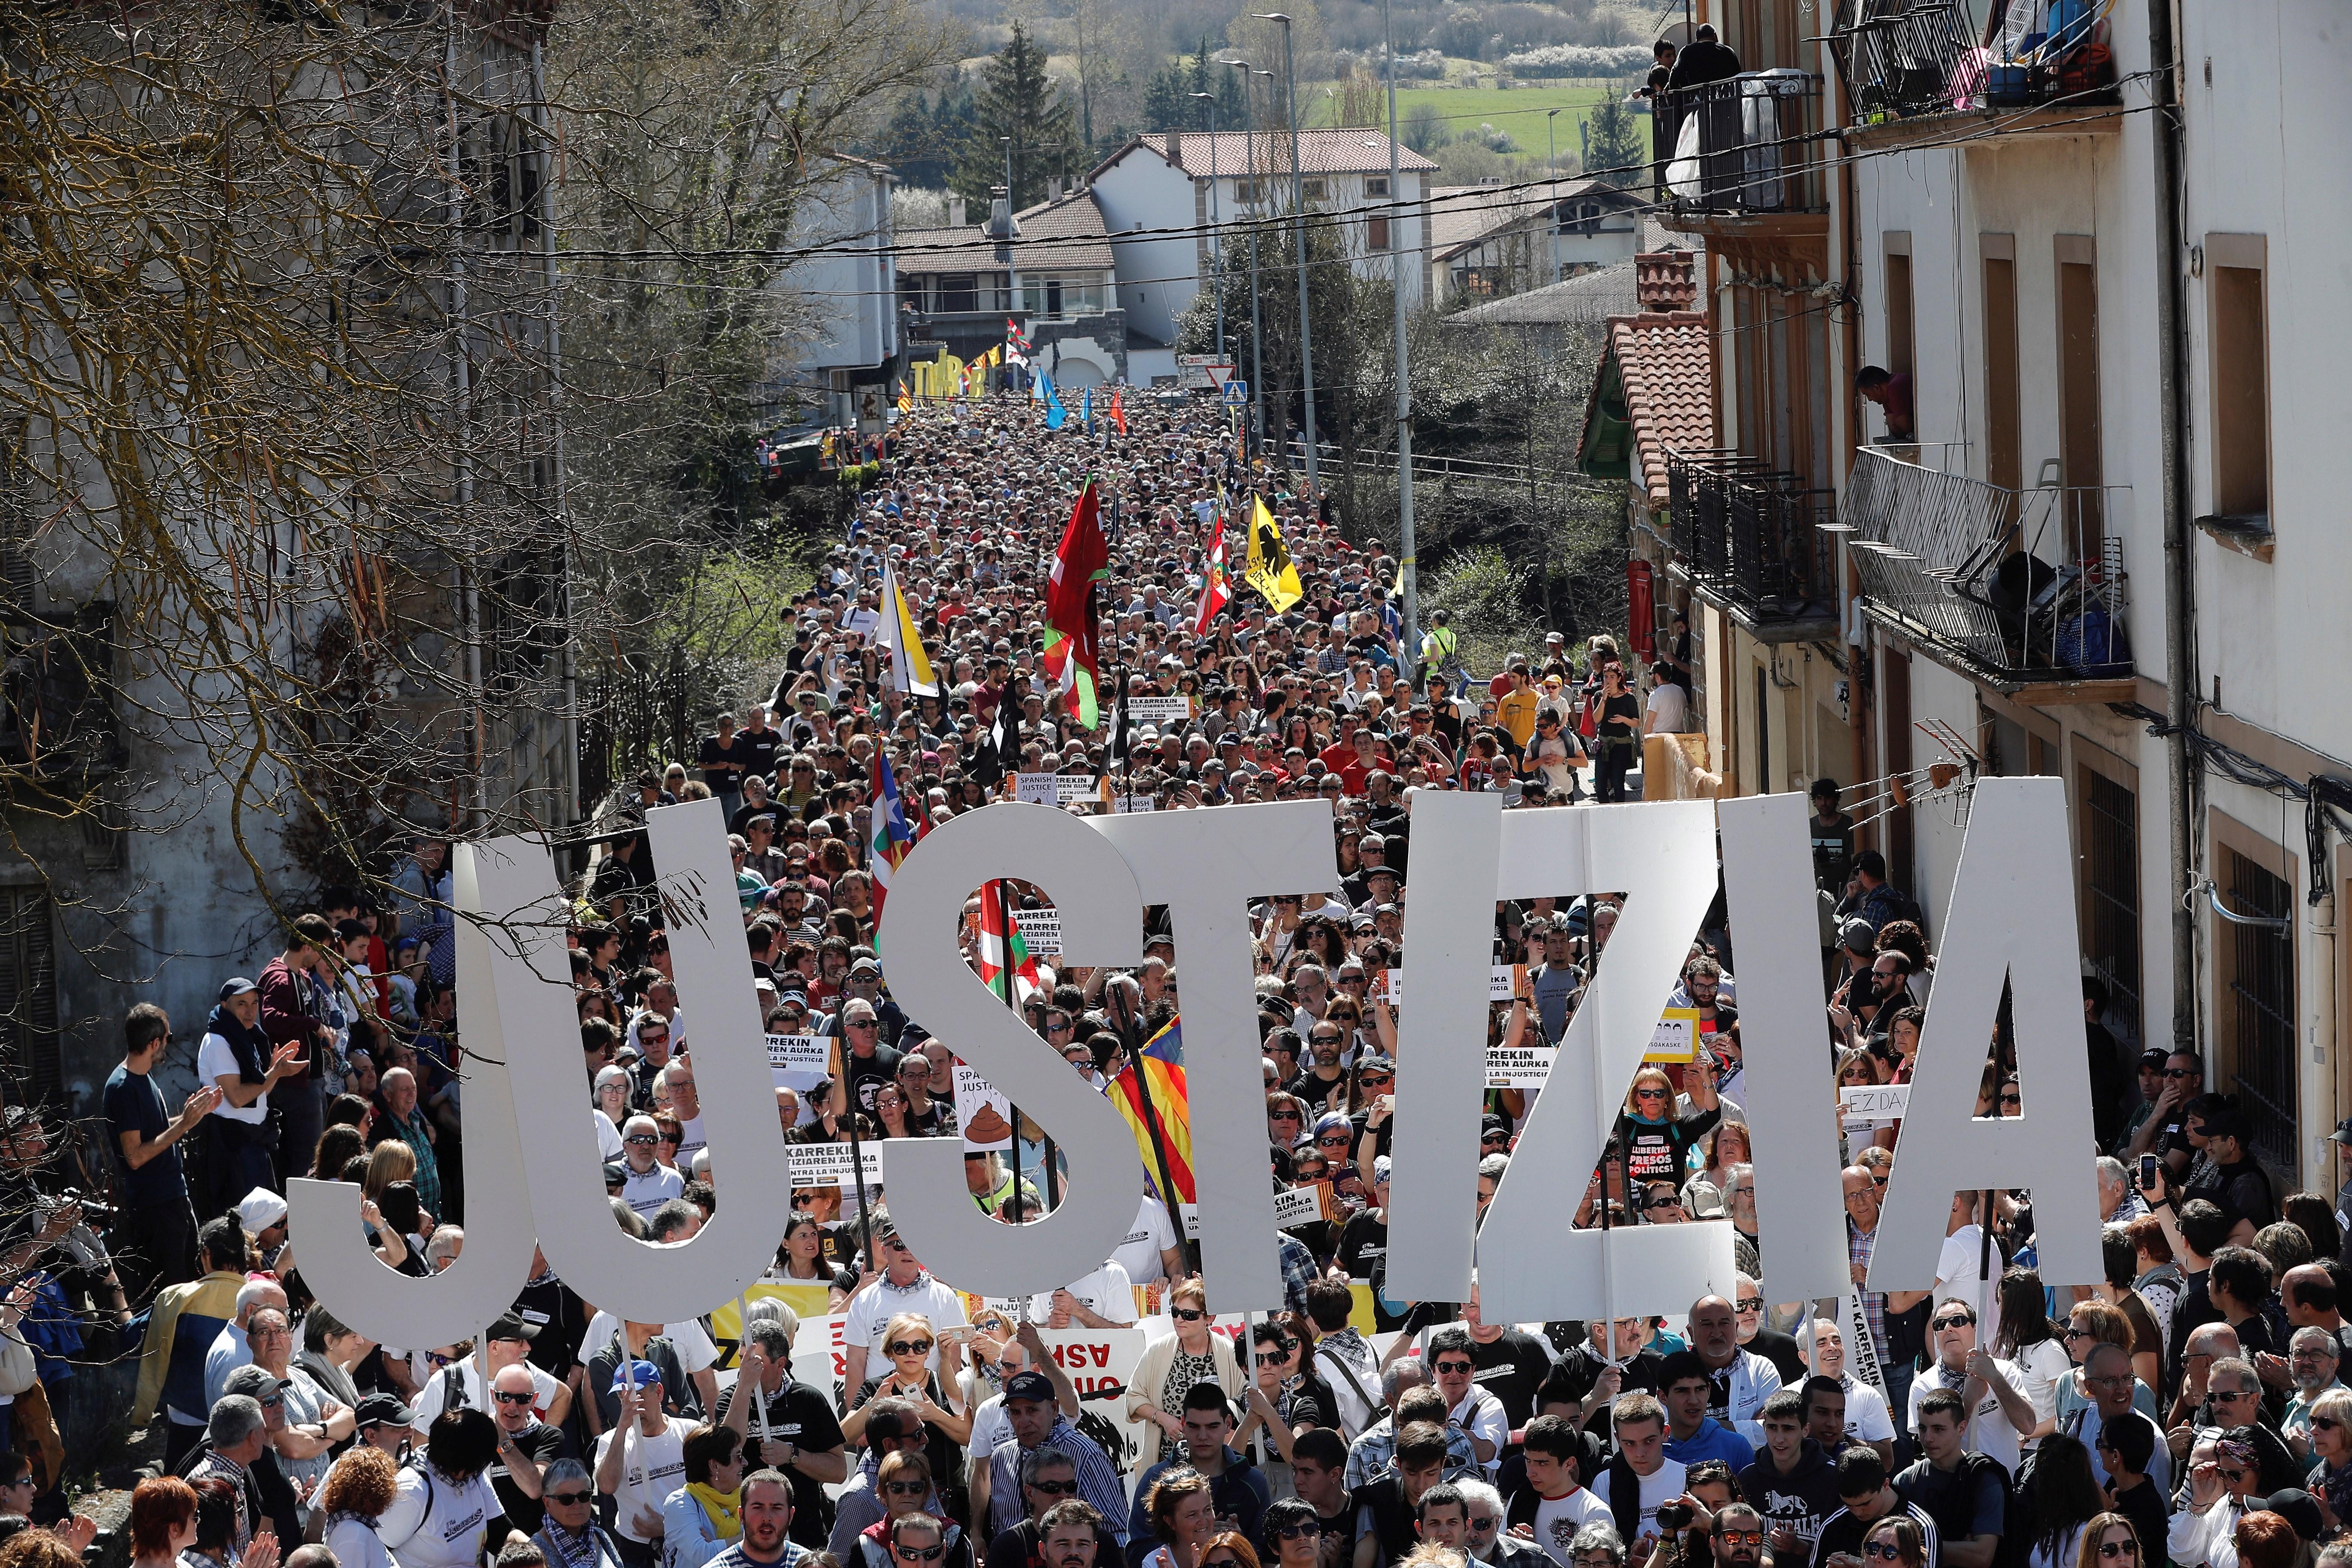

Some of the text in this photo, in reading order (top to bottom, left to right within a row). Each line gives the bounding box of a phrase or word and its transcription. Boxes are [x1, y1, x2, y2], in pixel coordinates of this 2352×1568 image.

[765, 1037, 811, 1047] RREKIN
[287, 776, 2105, 1350] JUSTIZIA
[959, 1071, 980, 1081] SPA
[962, 1082, 992, 1092] JUSTI
[1850, 1094, 1874, 1112] EZ
[786, 1145, 853, 1158] KARREKI
[1632, 1145, 1670, 1155] LLIBERTAT
[839, 1155, 876, 1164] AUKA
[1629, 1154, 1672, 1165] PRESOS
[830, 1166, 878, 1174] INJUSCIA
[1629, 1164, 1674, 1174] POLÍTICS!
[1276, 1197, 1312, 1213] AURKA
[1277, 1207, 1314, 1220] JUSTICIA
[1046, 1344, 1111, 1369] ASK
[1978, 1400, 1995, 1413] ASKE
